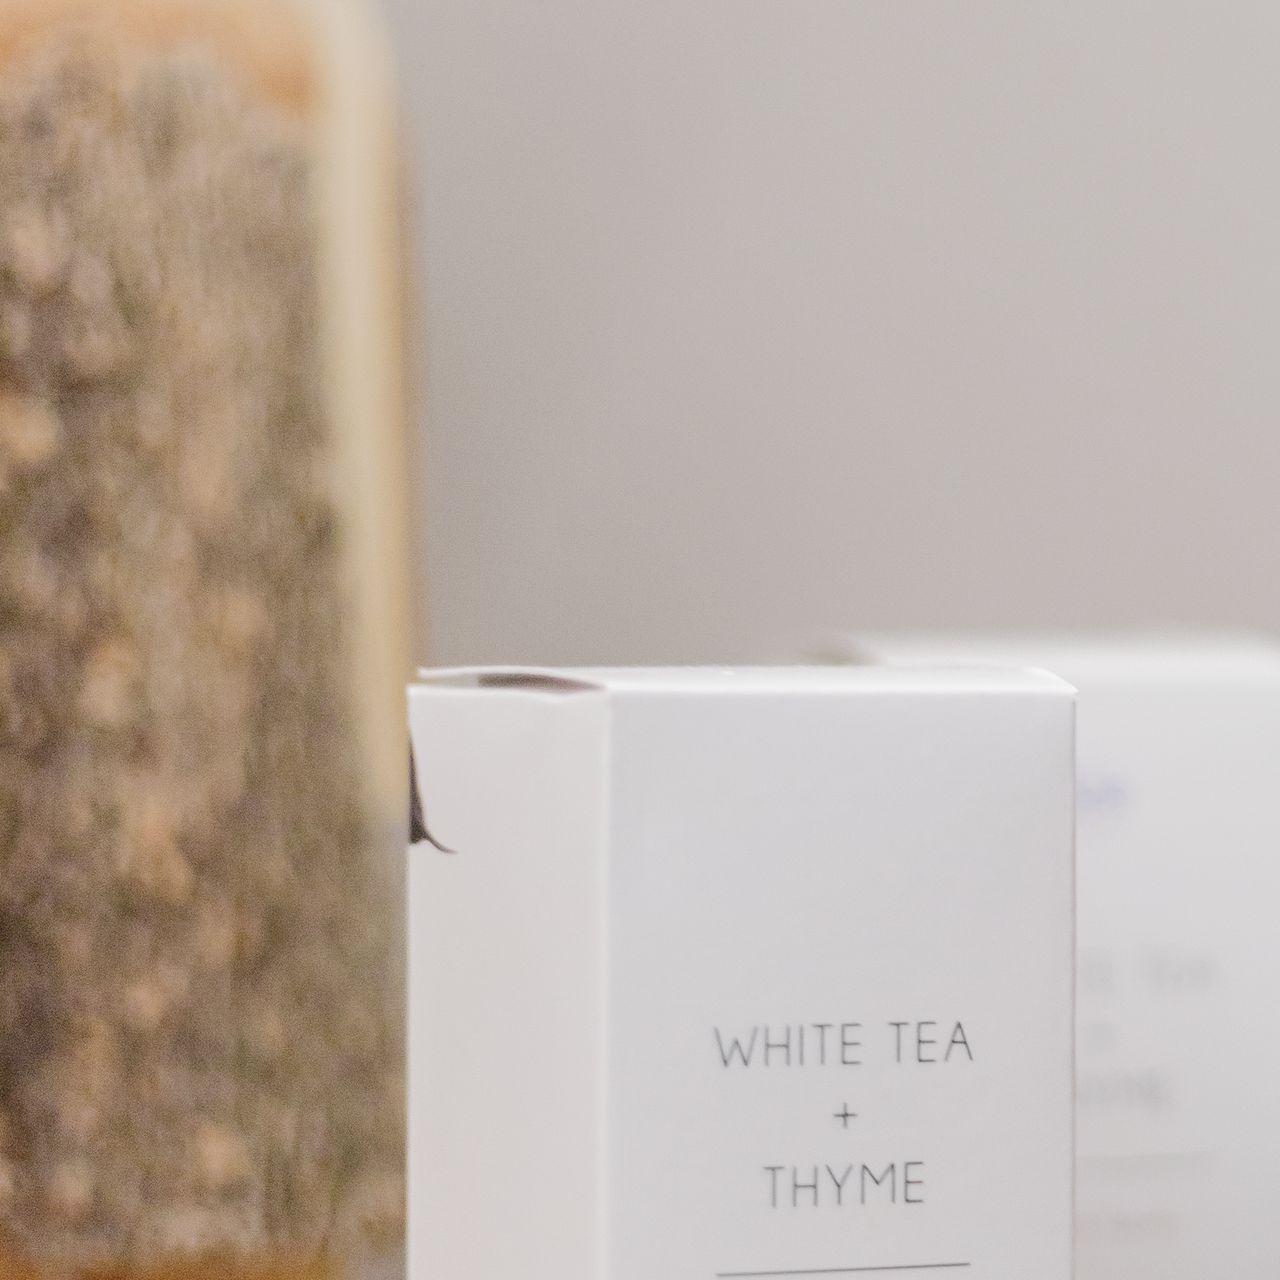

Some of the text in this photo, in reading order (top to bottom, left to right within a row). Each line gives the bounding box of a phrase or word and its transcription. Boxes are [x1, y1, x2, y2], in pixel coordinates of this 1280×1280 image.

[713, 1021, 974, 1068] WHITE TEA
[832, 1102, 858, 1128] +
[762, 1161, 925, 1208] THYME
